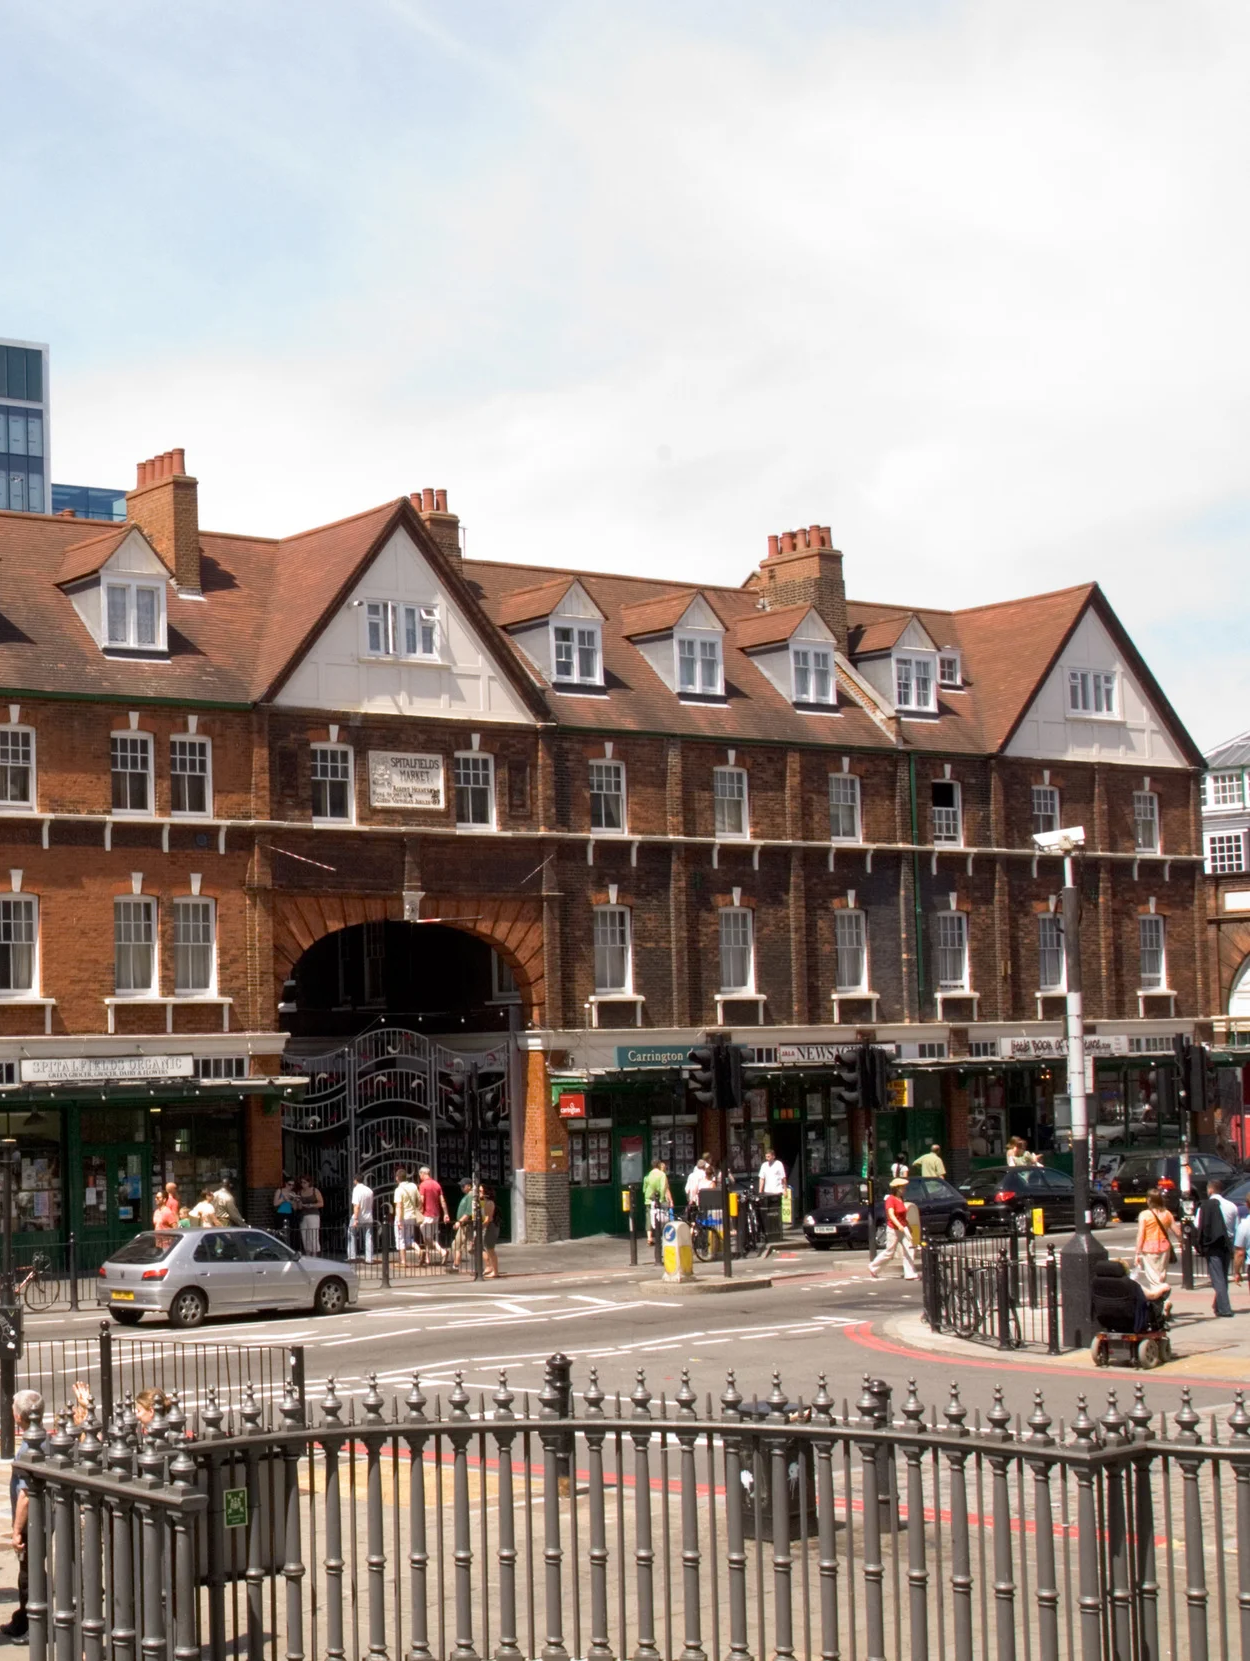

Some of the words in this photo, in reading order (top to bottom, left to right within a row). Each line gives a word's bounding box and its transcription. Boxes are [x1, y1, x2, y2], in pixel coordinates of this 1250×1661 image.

[390, 757, 440, 769] SPITALFIELDS
[627, 1050, 684, 1064] Carrington
[32, 1059, 125, 1073] SPITALFIELDS
[129, 1056, 183, 1071] ORGANIC
